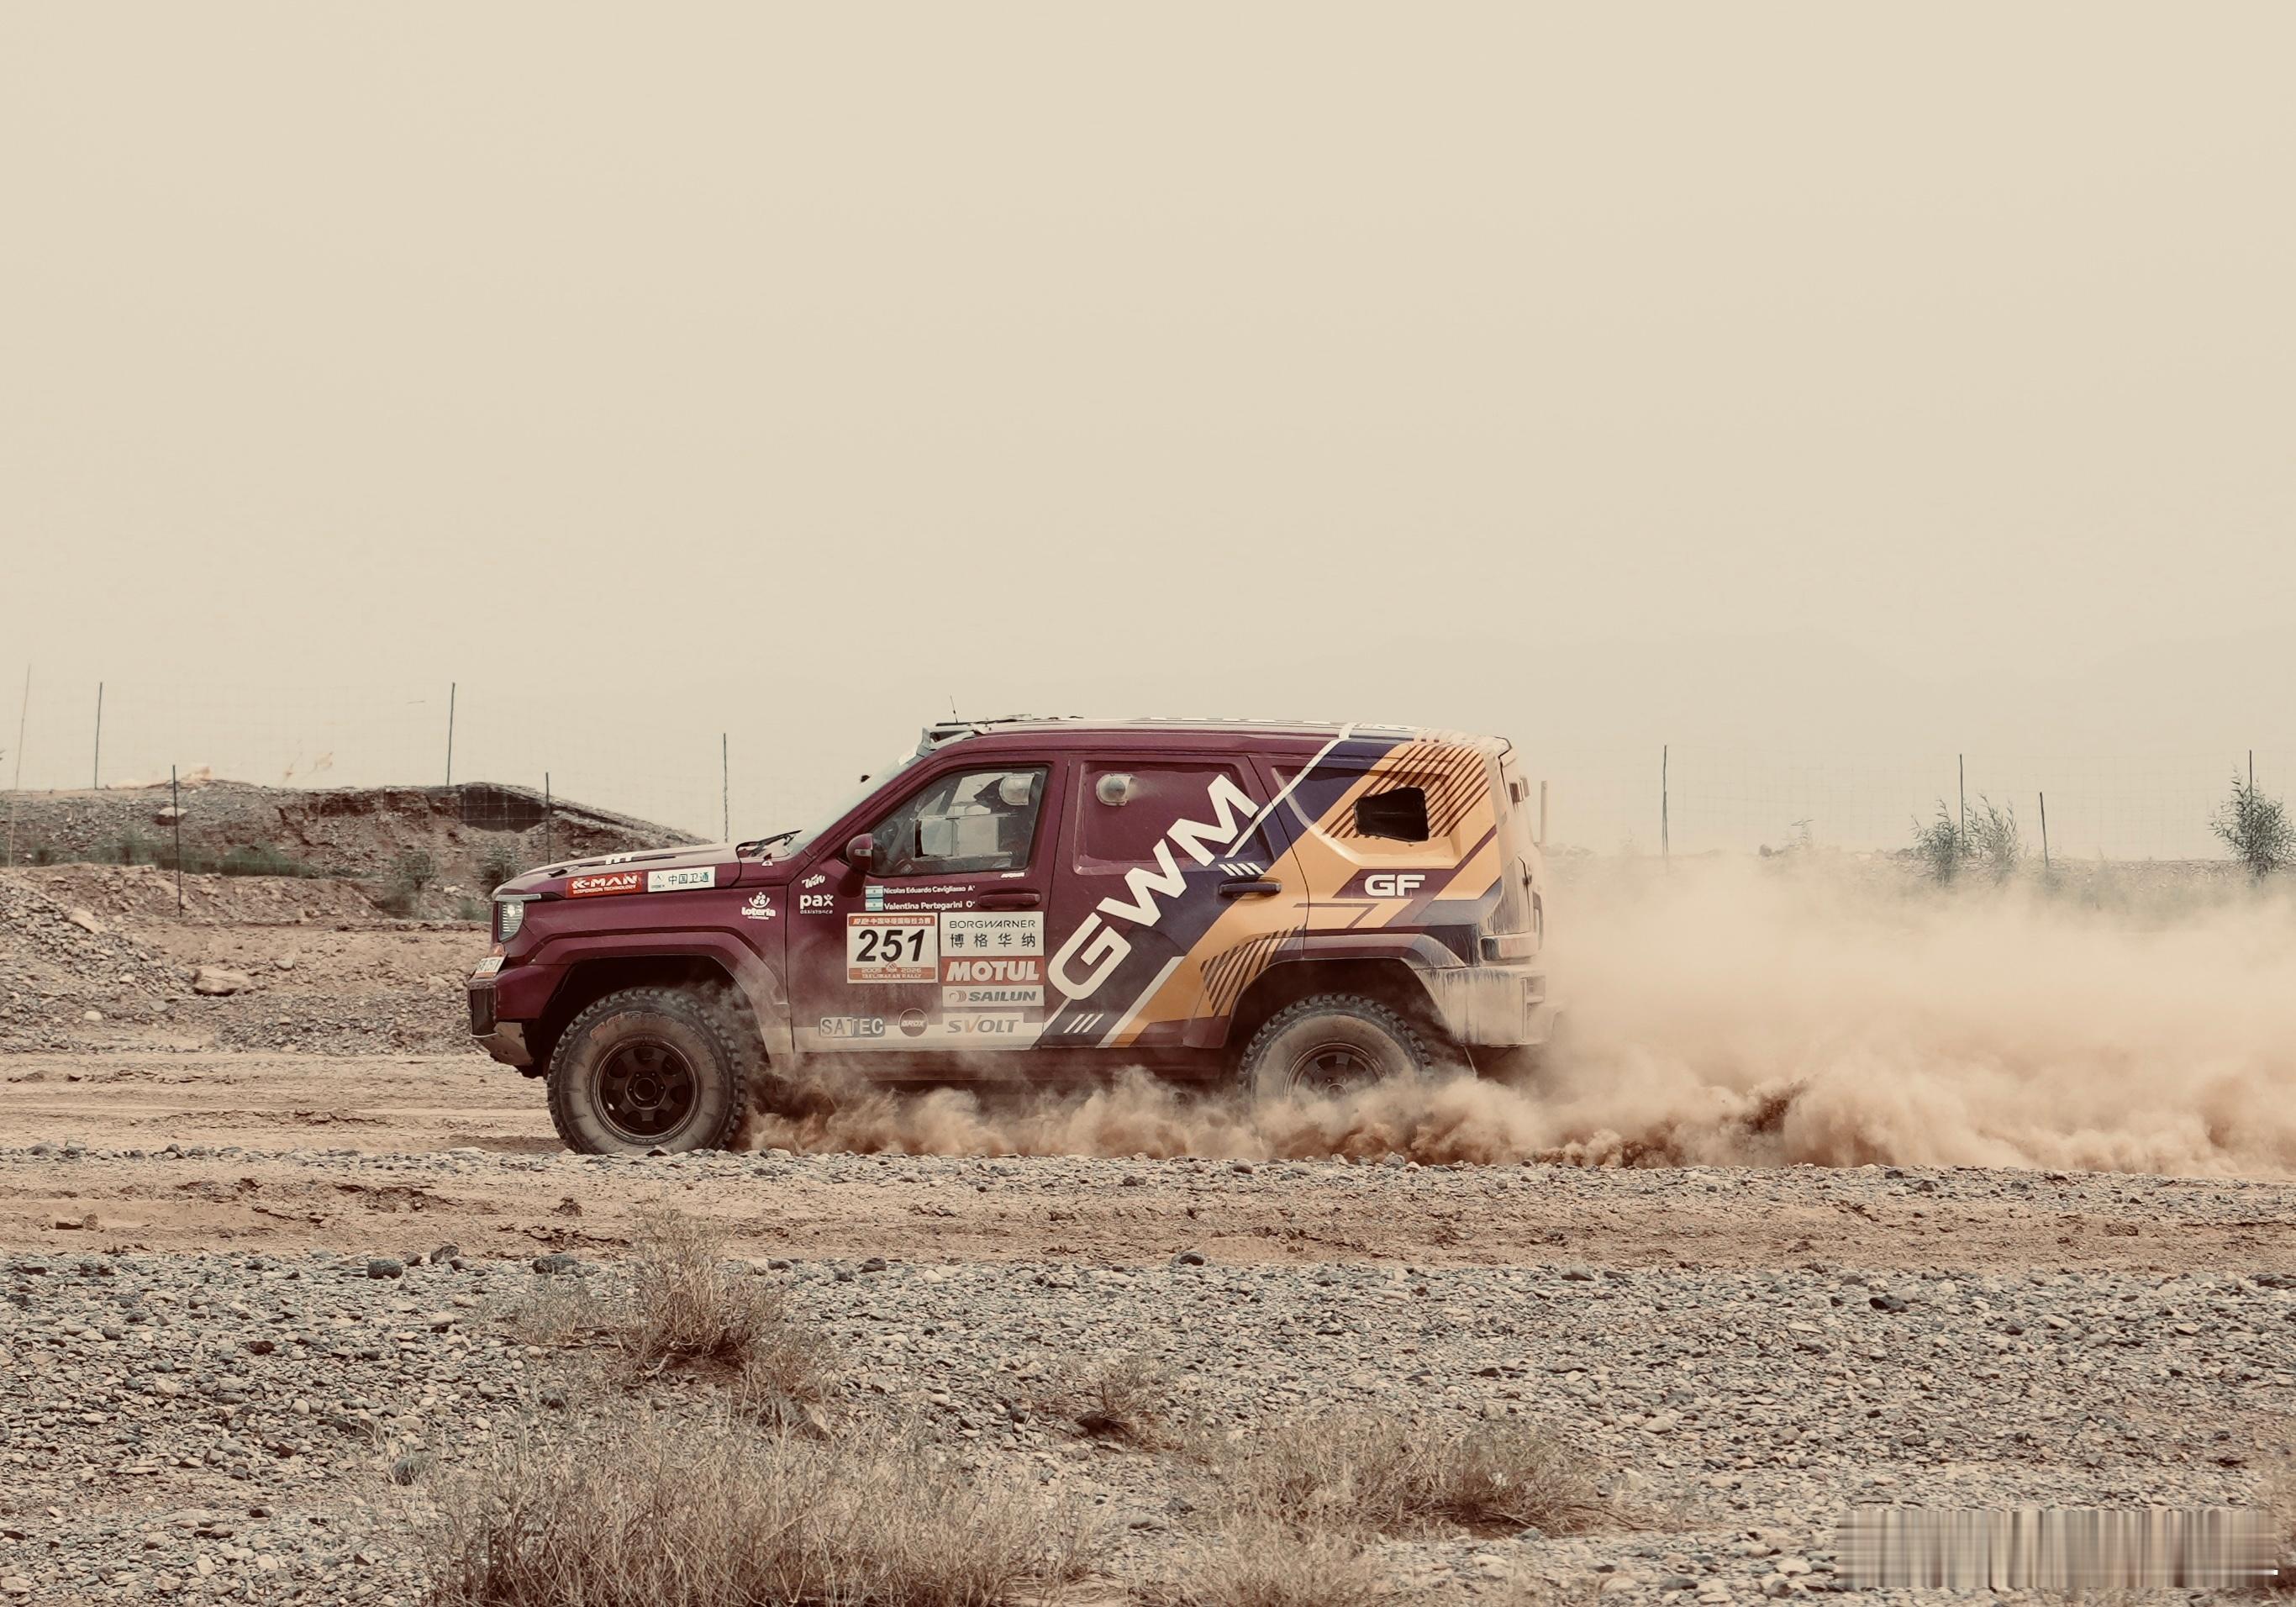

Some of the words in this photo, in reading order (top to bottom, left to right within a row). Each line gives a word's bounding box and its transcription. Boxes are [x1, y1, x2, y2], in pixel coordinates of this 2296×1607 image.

[571, 874, 638, 889] K-MAN
[668, 872, 709, 885] 中国卫通
[1364, 874, 1426, 897] GF
[1047, 773, 1260, 1001] GWM
[799, 893, 834, 909] pax
[884, 902, 919, 910] Valentina
[920, 901, 963, 911] Pertegarini
[949, 919, 1036, 929] BORGWARNER
[856, 929, 925, 962] 251
[950, 933, 1036, 948] 博格华纳
[945, 961, 1040, 982] MOTUL
[968, 991, 1036, 1002] SAILUN
[821, 1018, 883, 1035] SATEC
[946, 1014, 1019, 1033] SVOLT
